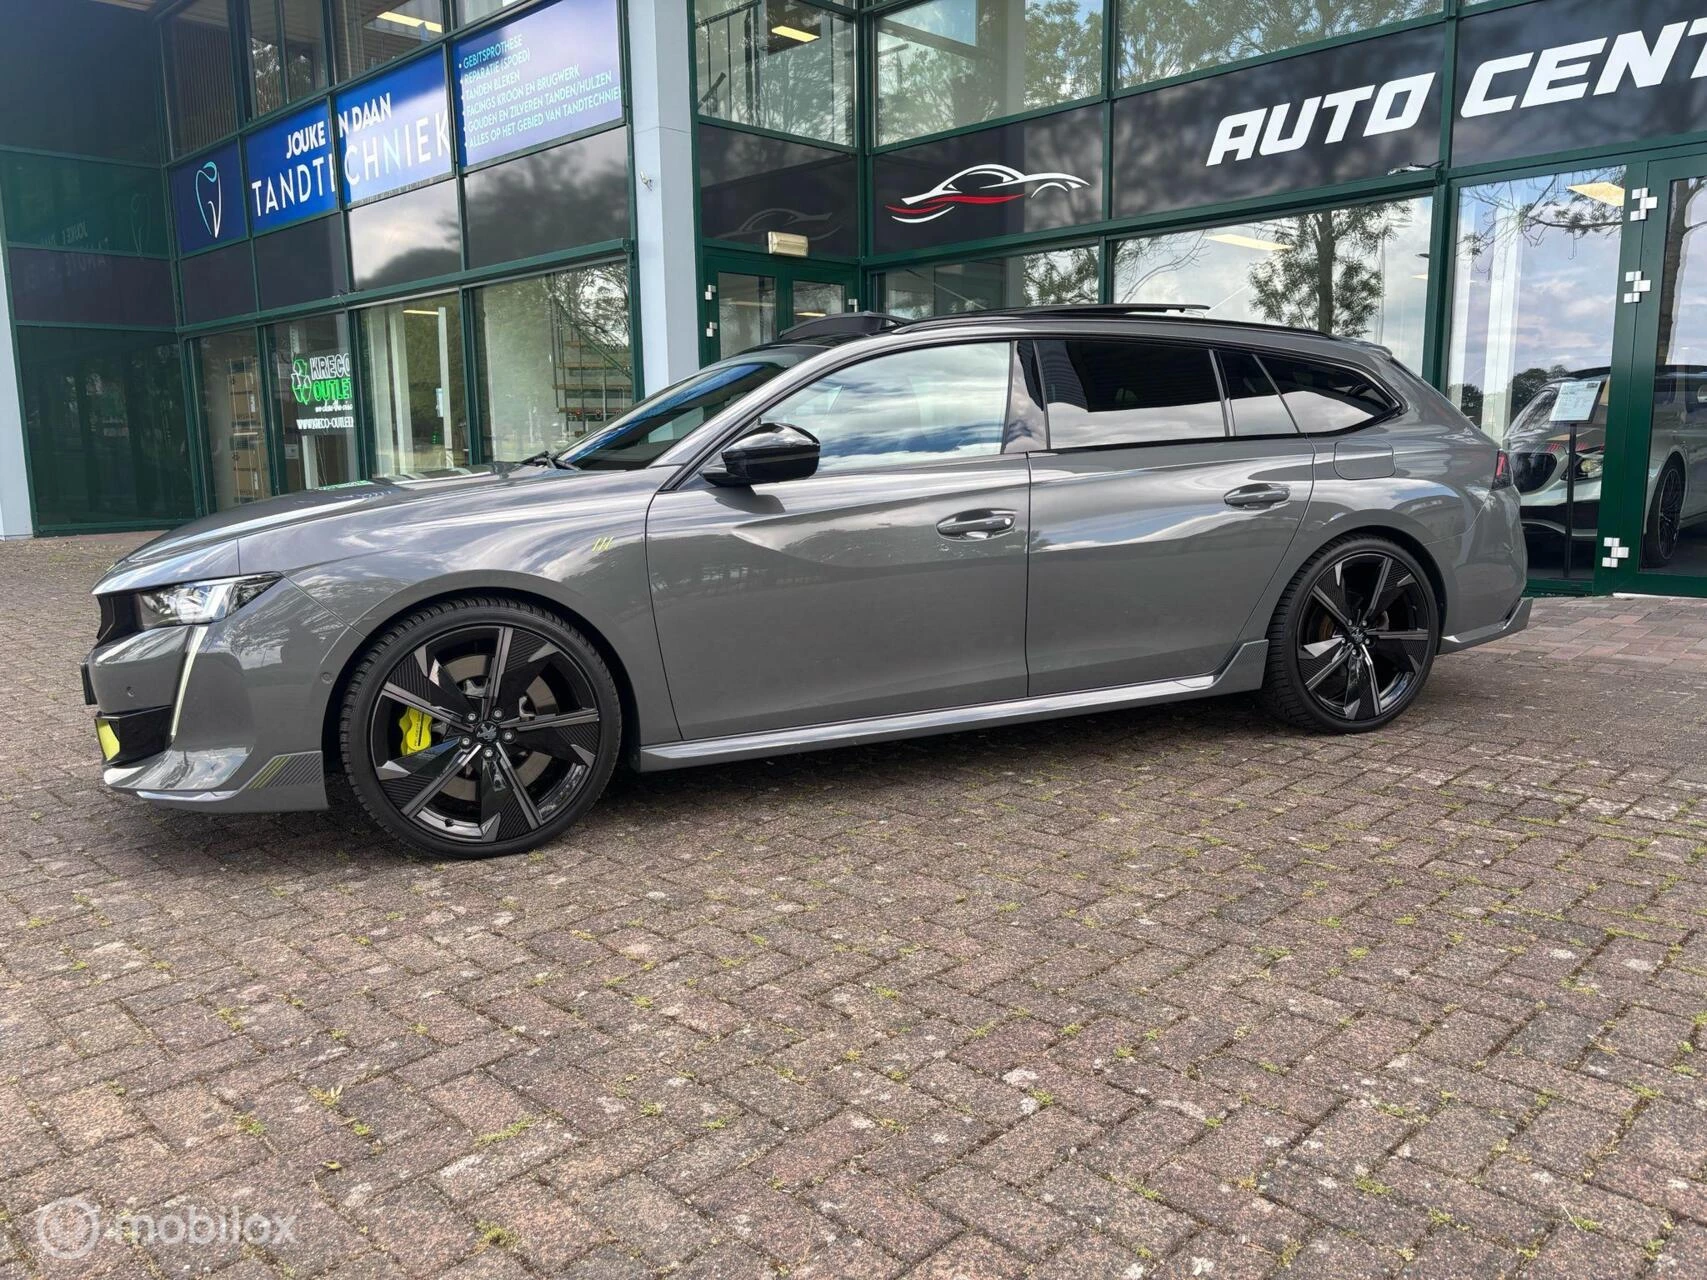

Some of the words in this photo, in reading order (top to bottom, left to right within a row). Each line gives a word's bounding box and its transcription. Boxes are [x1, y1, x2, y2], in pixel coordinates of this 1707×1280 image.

[463, 34, 523, 69] GEBITSPROTHESE
[464, 60, 500, 85] REPARATIE
[501, 48, 531, 73] (SPOED)
[465, 80, 493, 100] TANDEN
[494, 70, 521, 91] BLEKEN
[466, 97, 497, 117] FACINGS
[497, 87, 525, 107] KROON
[525, 82, 535, 96] EN
[537, 63, 581, 92] BRUGWERK
[286, 120, 326, 160] JOUKE
[352, 92, 392, 133] DAAN
[468, 112, 498, 133] GOUDEN
[499, 108, 509, 121] EN
[510, 97, 543, 119] ZILVEREN
[469, 131, 490, 148] ALLES
[491, 127, 501, 141] OP
[502, 121, 517, 137] HET
[517, 113, 544, 132] GEBIED
[545, 106, 562, 122] VAN
[1205, 72, 1436, 167] AUTO
